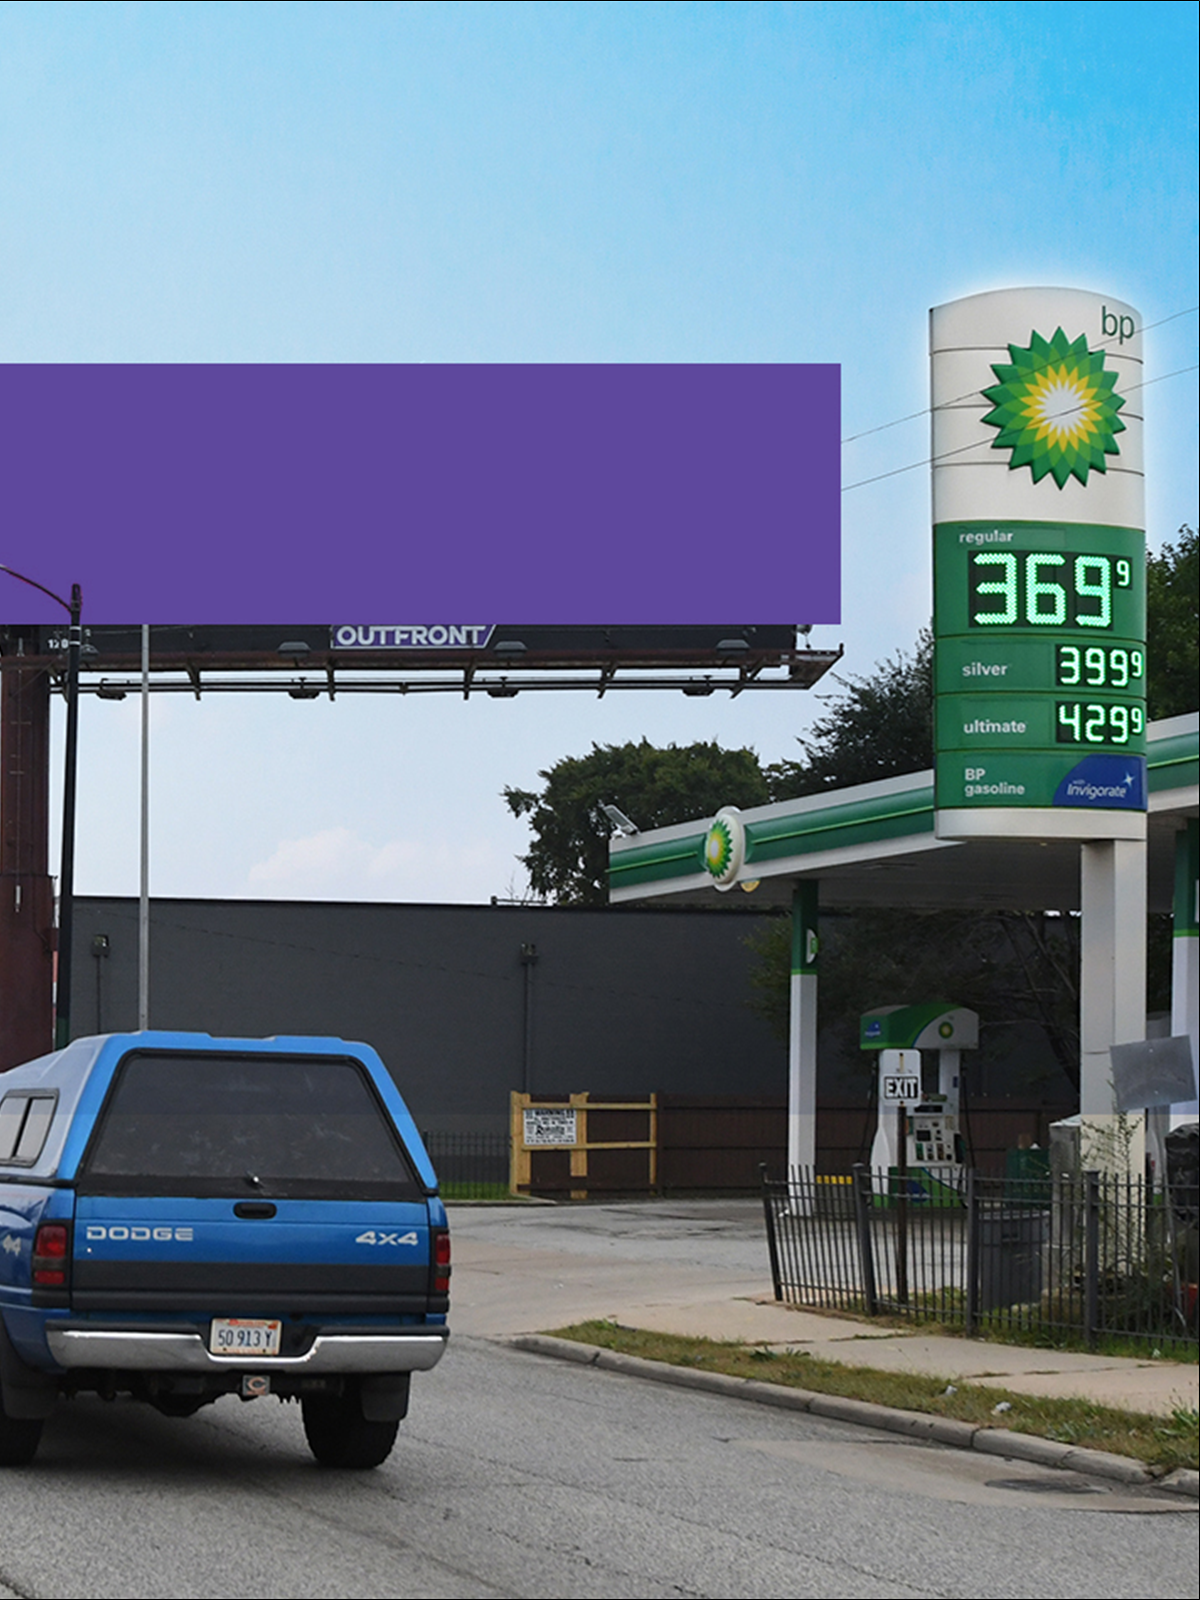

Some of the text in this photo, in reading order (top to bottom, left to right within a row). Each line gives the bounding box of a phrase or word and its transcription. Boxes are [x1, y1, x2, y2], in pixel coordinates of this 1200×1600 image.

[1102, 305, 1135, 345] bp
[959, 530, 1014, 545] regular
[336, 625, 486, 646] OUTFRONT
[962, 662, 1008, 677] silver
[963, 719, 1027, 734] ultimate
[964, 768, 986, 781] BP
[964, 782, 1026, 797] gasoline
[1067, 783, 1127, 799] Invigorate
[885, 1079, 917, 1098] EXIT
[87, 1226, 193, 1241] DODGE
[218, 1329, 272, 1347] 50 913 Y
